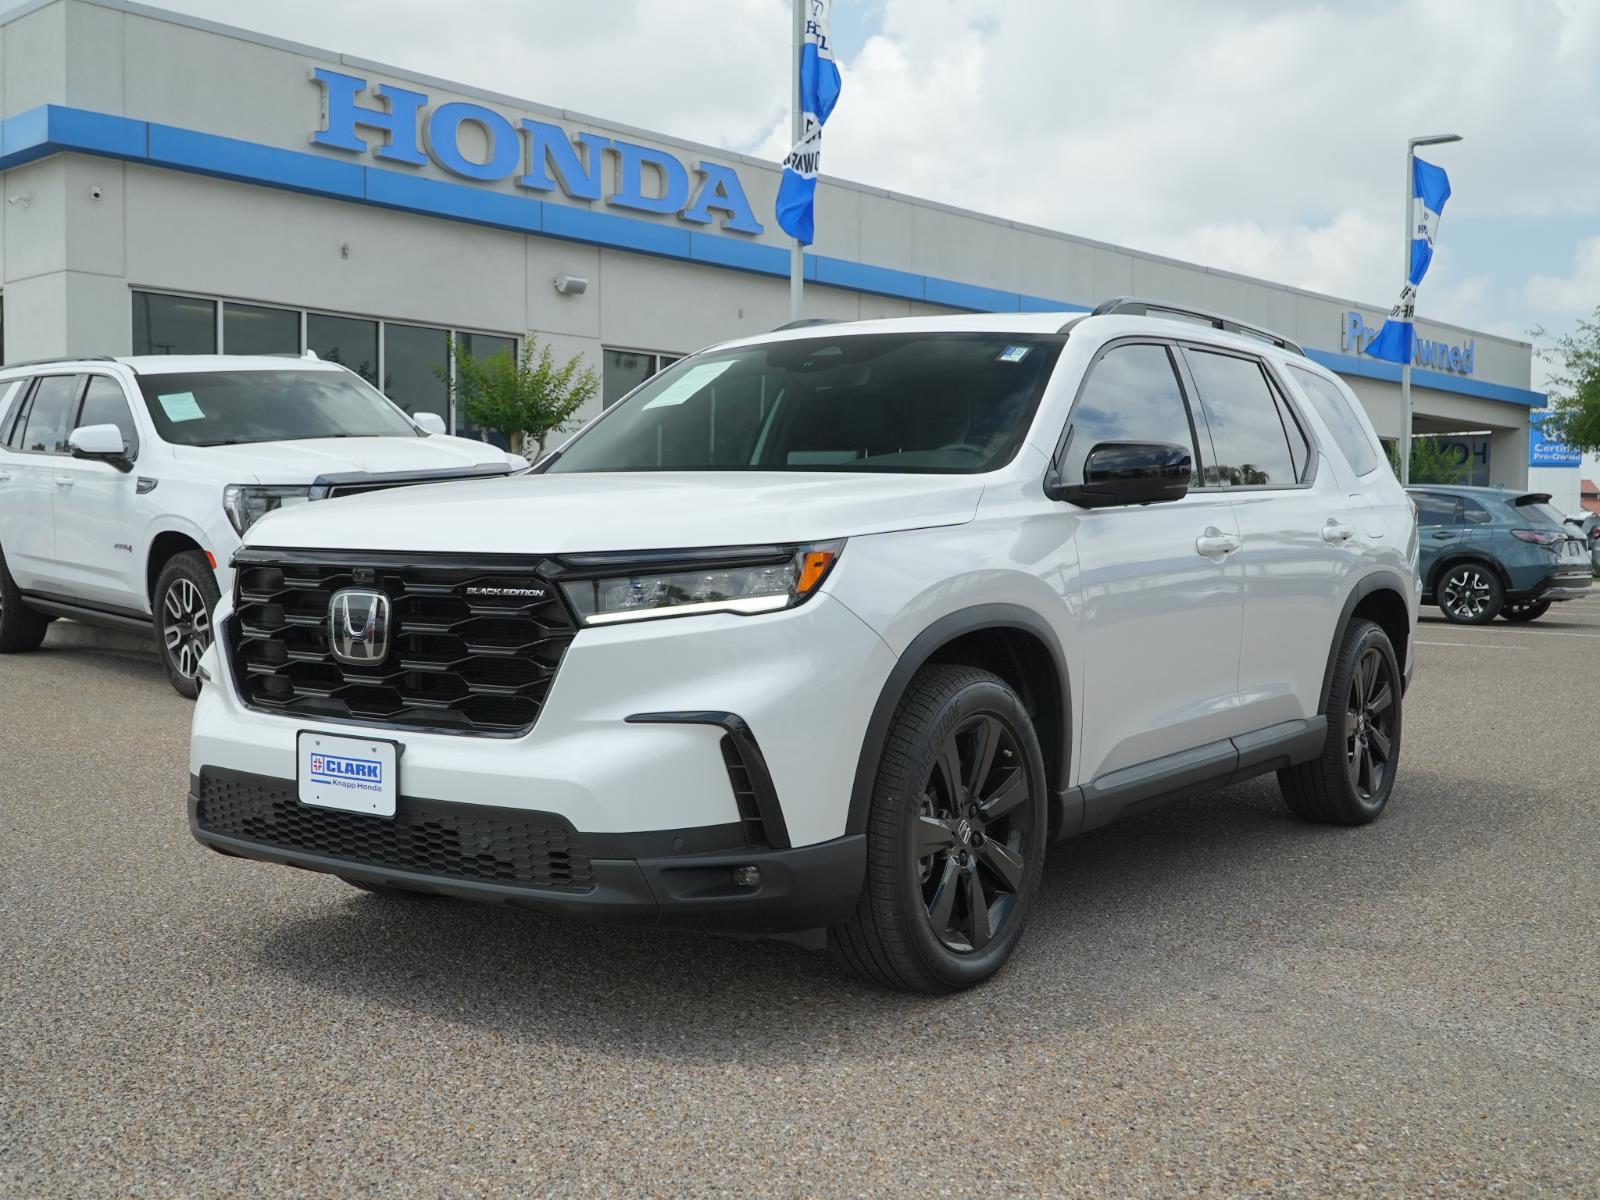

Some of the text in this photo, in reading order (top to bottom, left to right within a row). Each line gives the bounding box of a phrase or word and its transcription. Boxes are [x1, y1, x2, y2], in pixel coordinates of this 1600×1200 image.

[310, 68, 764, 235] HONDA
[466, 587, 544, 597] BLACK EDITION
[326, 759, 378, 778] CLARK
[332, 778, 382, 792] Knapp Honda
